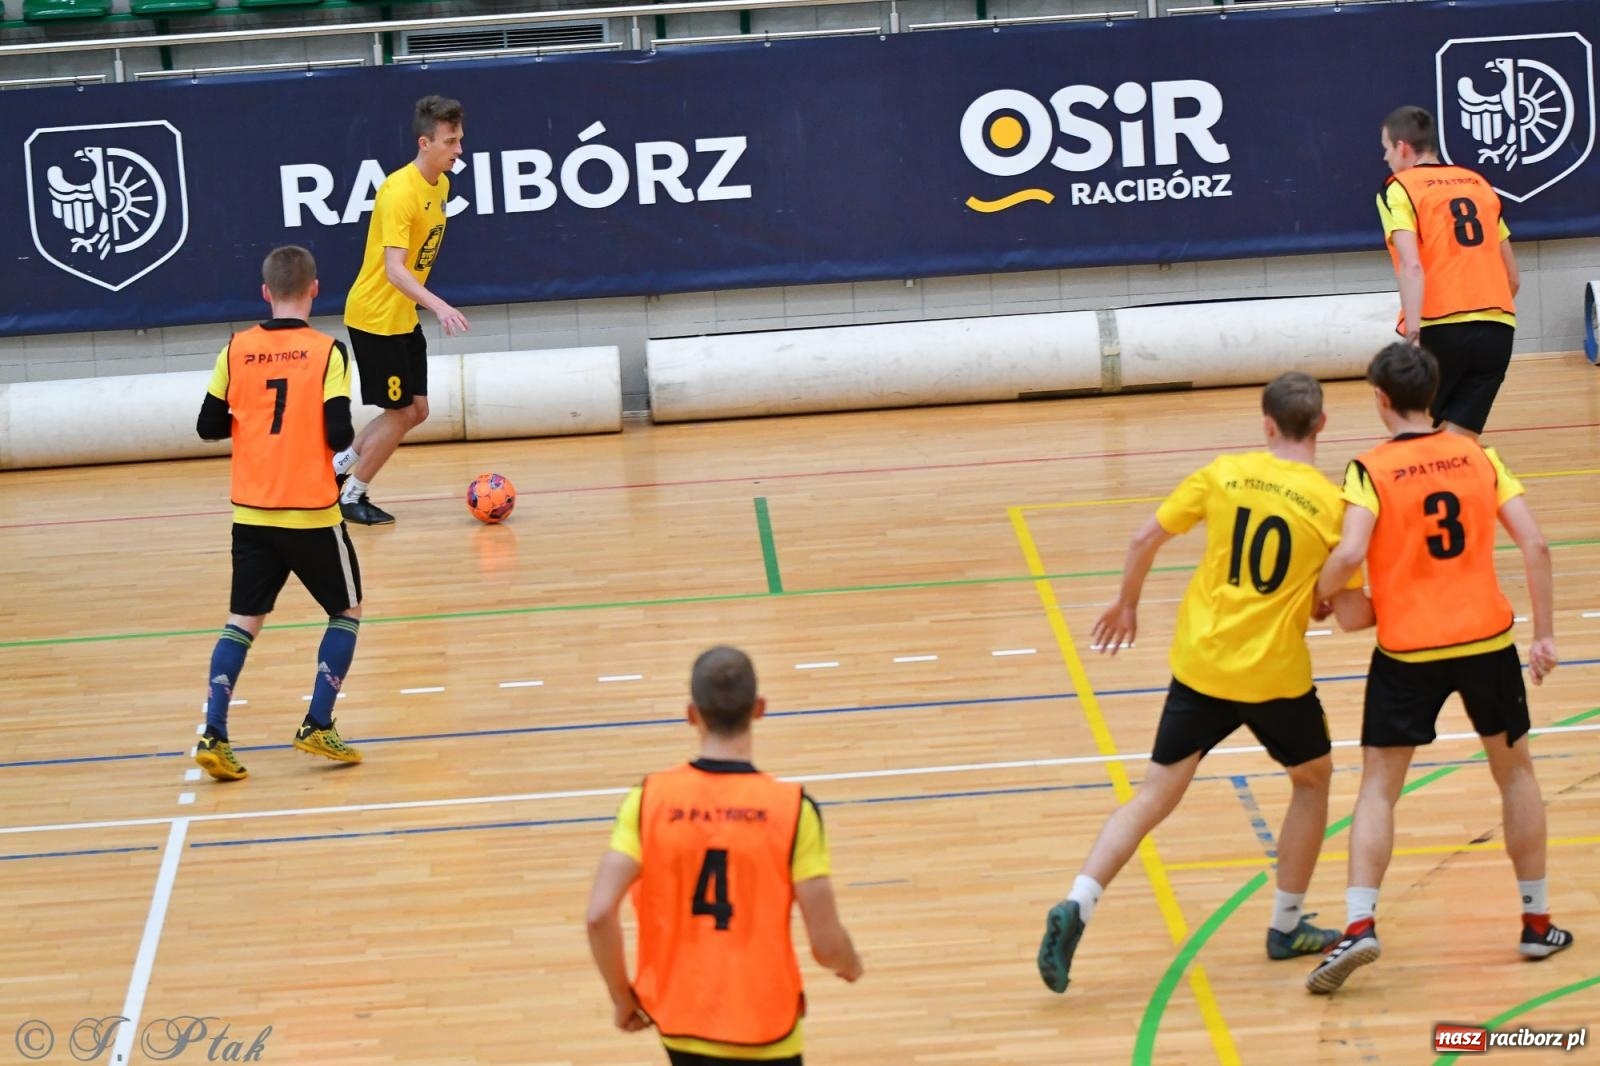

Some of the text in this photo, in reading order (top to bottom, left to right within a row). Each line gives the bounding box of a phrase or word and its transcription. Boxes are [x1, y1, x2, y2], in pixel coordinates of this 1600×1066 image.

[1071, 169, 1232, 205] RACIBÓRZ
[1449, 197, 1484, 247] 8
[258, 350, 309, 364] PATRICK
[388, 375, 402, 402] 8
[1408, 456, 1470, 476] PATRICK
[1423, 491, 1466, 560] 3
[1227, 505, 1292, 596] 10
[691, 848, 734, 931] 4
